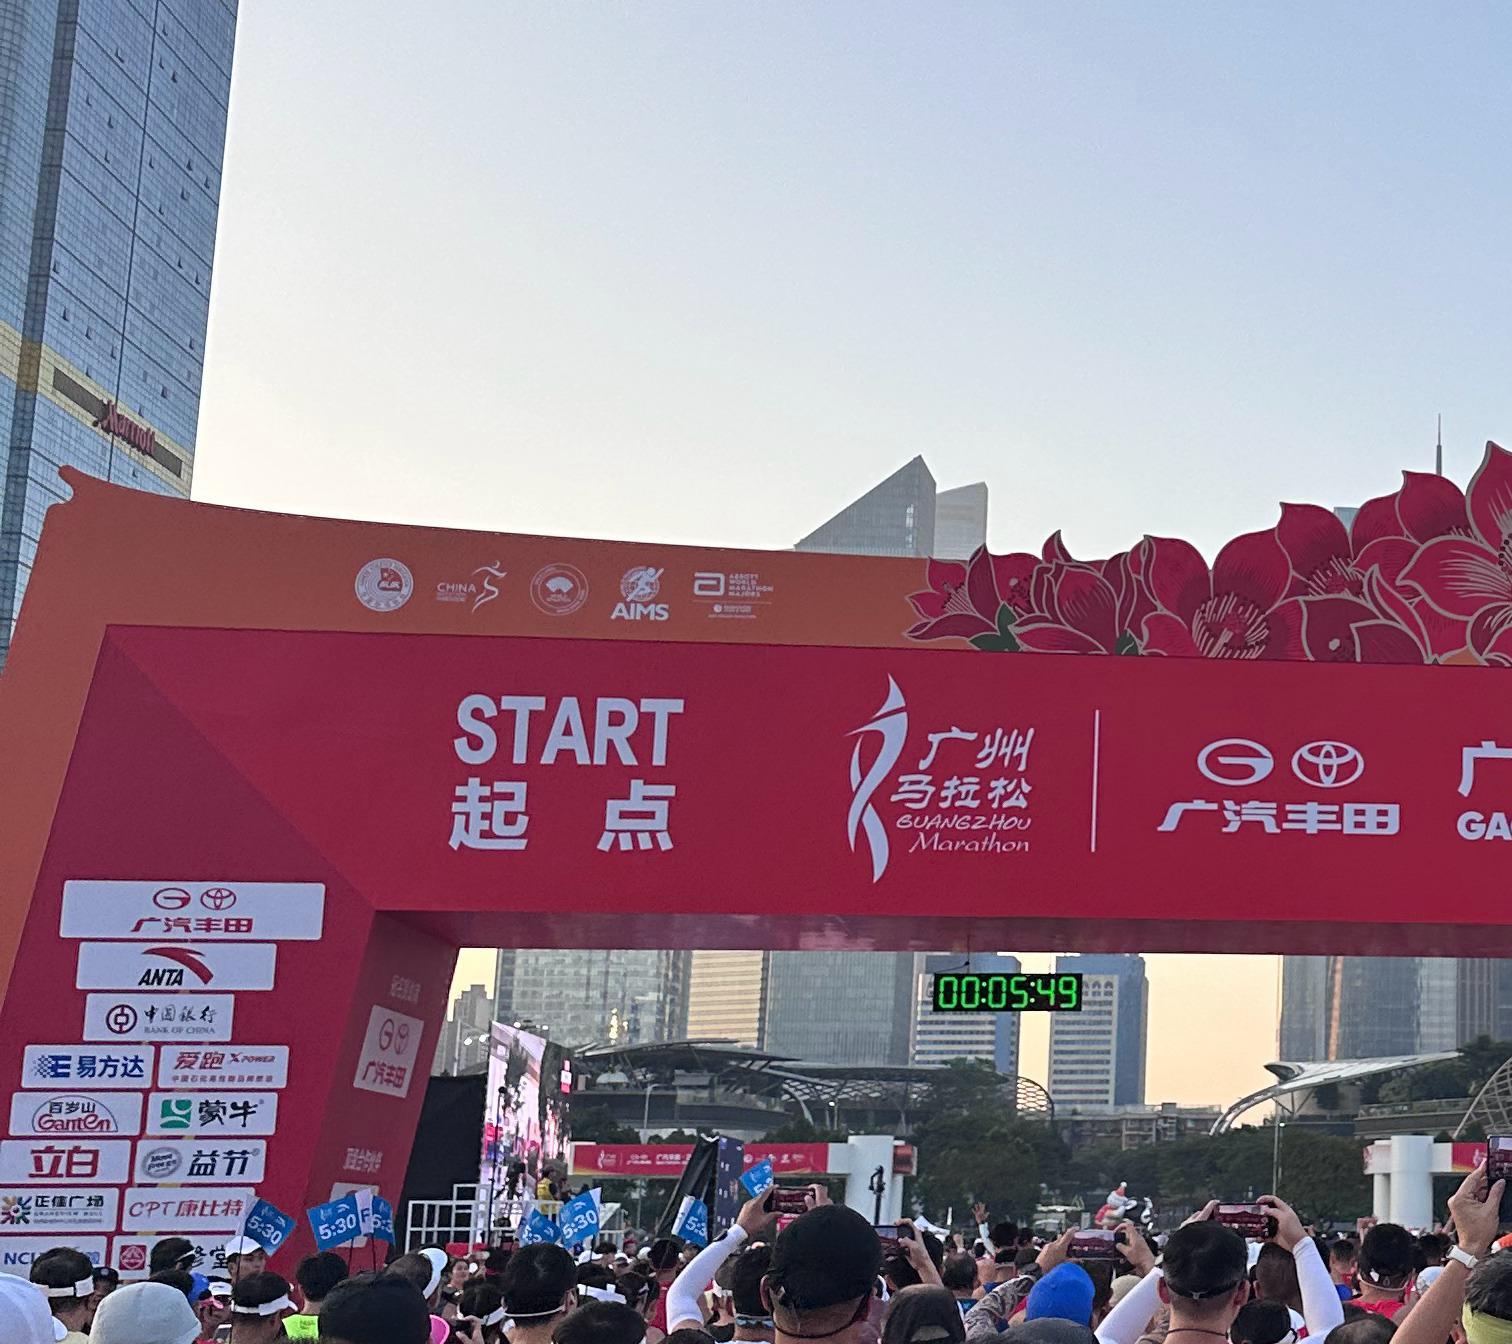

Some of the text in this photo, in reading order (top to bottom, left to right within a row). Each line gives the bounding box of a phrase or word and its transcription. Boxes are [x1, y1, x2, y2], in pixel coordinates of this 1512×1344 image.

[610, 602, 669, 621] AIMS
[453, 694, 686, 766] START
[918, 726, 1036, 771] 广州
[889, 774, 1032, 810] 马拉松
[448, 777, 677, 852] 起点
[896, 813, 1032, 831] GUANGZHOU
[1157, 799, 1400, 835] 广汽丰田
[908, 831, 1029, 854] Marathon
[130, 917, 253, 934] 广汽丰田
[138, 968, 184, 986] ANTA
[938, 976, 1078, 1009] 00:05:49
[186, 1026, 215, 1034] CHINA
[76, 1054, 145, 1079] 易方达
[174, 1051, 226, 1070] 爱跑
[48, 1101, 96, 1114] 百岁山
[198, 1100, 257, 1128] 蒙牛
[38, 1113, 111, 1131] Ganten
[28, 1145, 100, 1179] 立白
[187, 1150, 249, 1177] 益节
[35, 1195, 104, 1208] 正佳广场
[248, 1216, 283, 1245] 5:30
[318, 1213, 357, 1240] 5:30
[562, 1209, 598, 1239] 5:30
